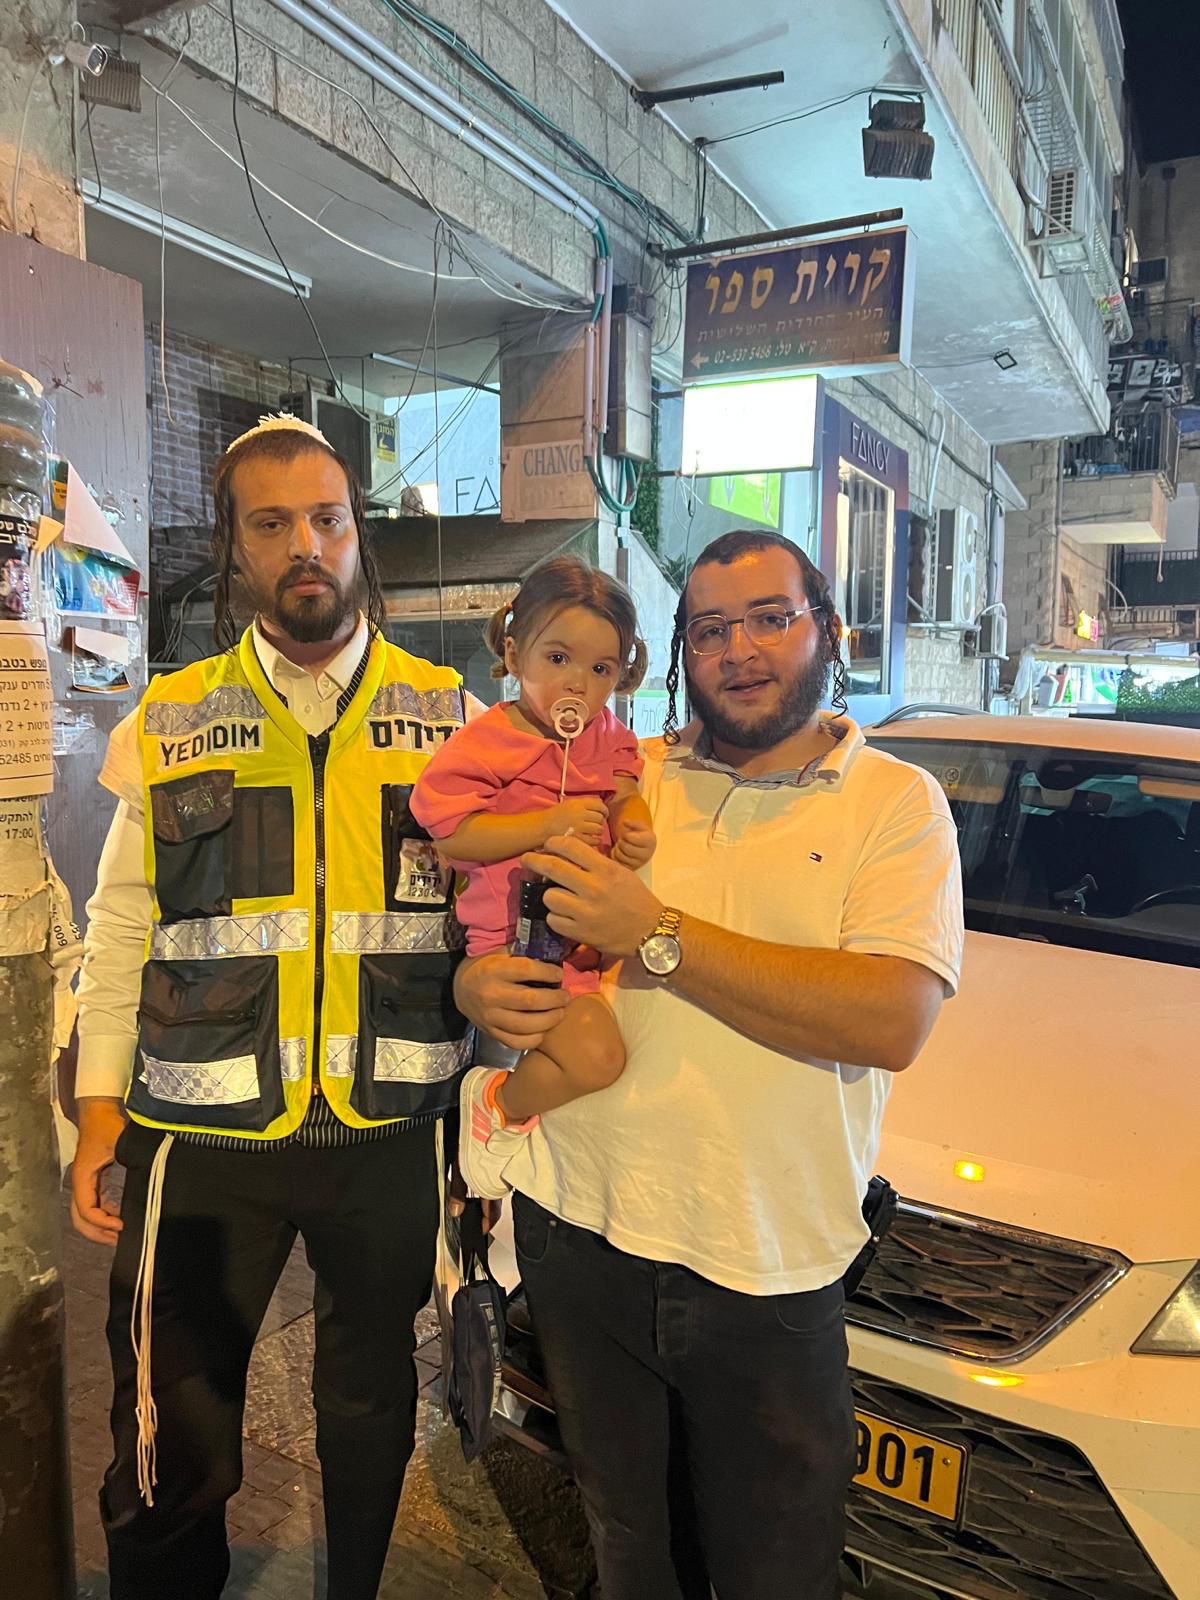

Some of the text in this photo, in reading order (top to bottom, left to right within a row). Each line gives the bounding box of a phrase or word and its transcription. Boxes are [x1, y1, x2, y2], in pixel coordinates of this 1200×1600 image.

[705, 248, 891, 315] קרית ספר
[847, 308, 884, 321] העיר
[523, 445, 584, 477] CHANG
[851, 421, 890, 474] FANCY
[0, 658, 27, 668] בטב
[23, 699, 31, 711] 2
[6, 720, 14, 732] 2
[369, 718, 460, 749] דידים
[160, 723, 260, 767] YEDIDIM
